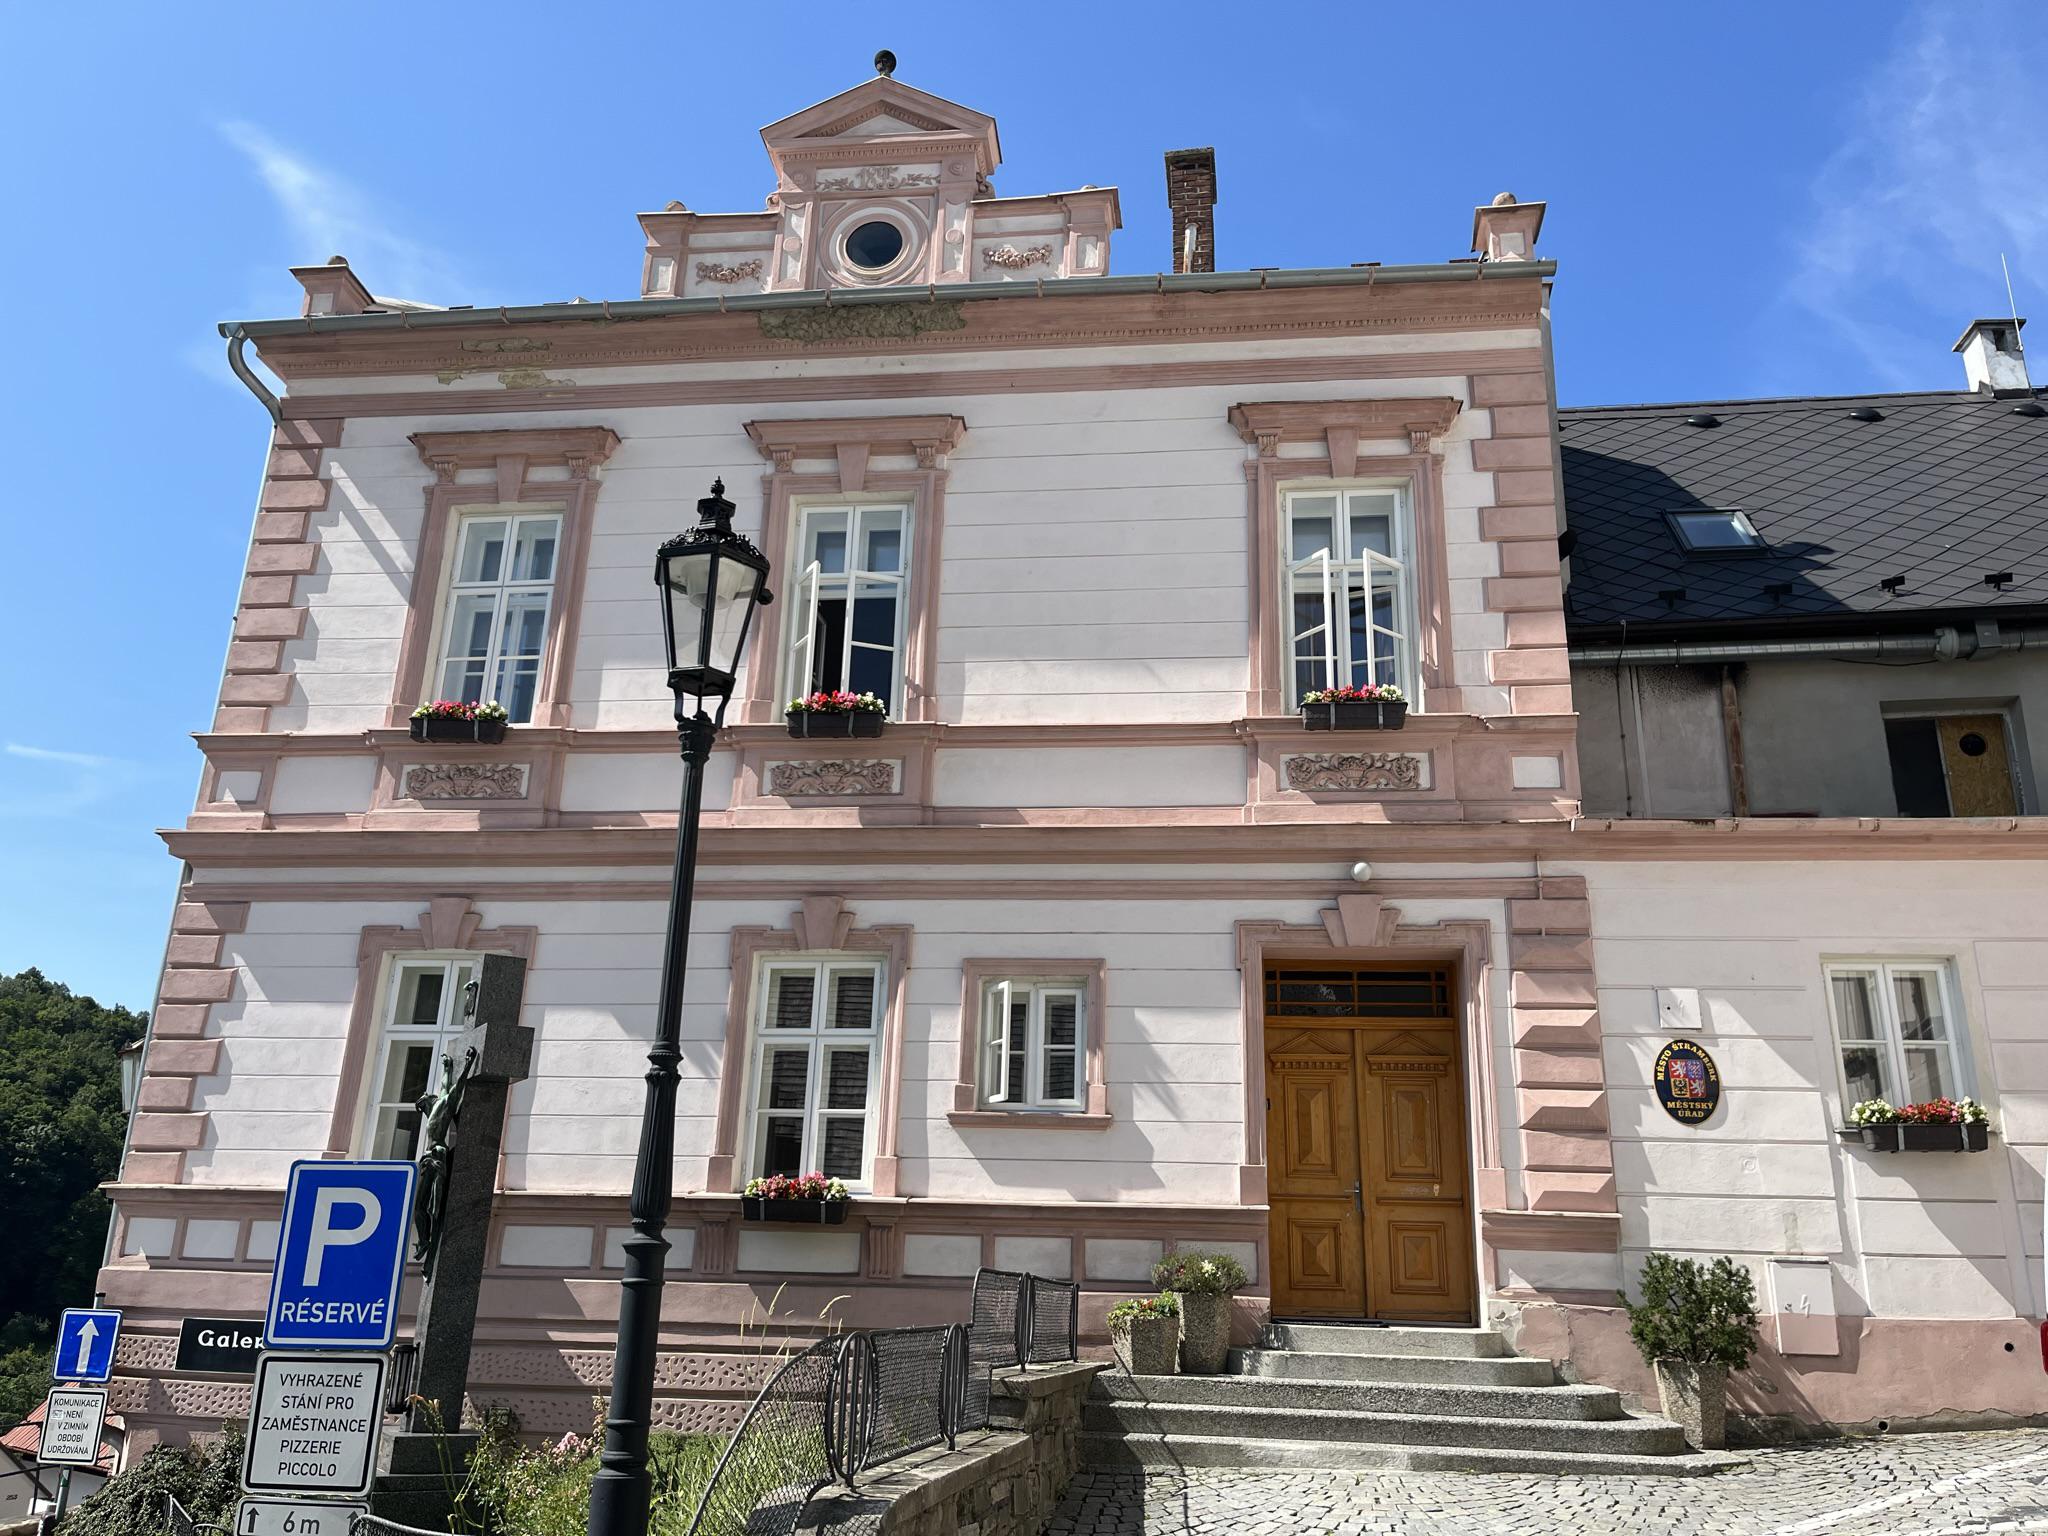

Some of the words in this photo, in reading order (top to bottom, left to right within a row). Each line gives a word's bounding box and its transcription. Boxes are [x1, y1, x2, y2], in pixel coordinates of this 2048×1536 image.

[1656, 1050, 1672, 1081] MĚSTO
[1672, 1042, 1718, 1082] ŠTRAMBERK
[1667, 1099, 1713, 1110] MĚSTSKÝ
[1678, 1107, 1704, 1118] ÚŘAD
[302, 1187, 382, 1287] P
[280, 1297, 385, 1324] RÉSERVÉ
[280, 1372, 363, 1388] VYHRAZENÉ
[54, 1398, 100, 1408] KOMUNIKACE
[281, 1393, 323, 1410] STÁNÍ
[325, 1397, 354, 1410] PRO
[65, 1409, 84, 1419] NENÍ
[57, 1421, 63, 1430] V
[63, 1421, 89, 1431] ZIMNÍM
[262, 1415, 367, 1432] ZAMĚSTNANCE
[57, 1433, 84, 1443] OBDOBÍ
[47, 1445, 89, 1455] UDRŽOVÁNA
[280, 1440, 341, 1455] PIZZERIE
[278, 1462, 337, 1477] PICCOLO
[283, 1511, 295, 1533] 6
[300, 1518, 320, 1535] m
